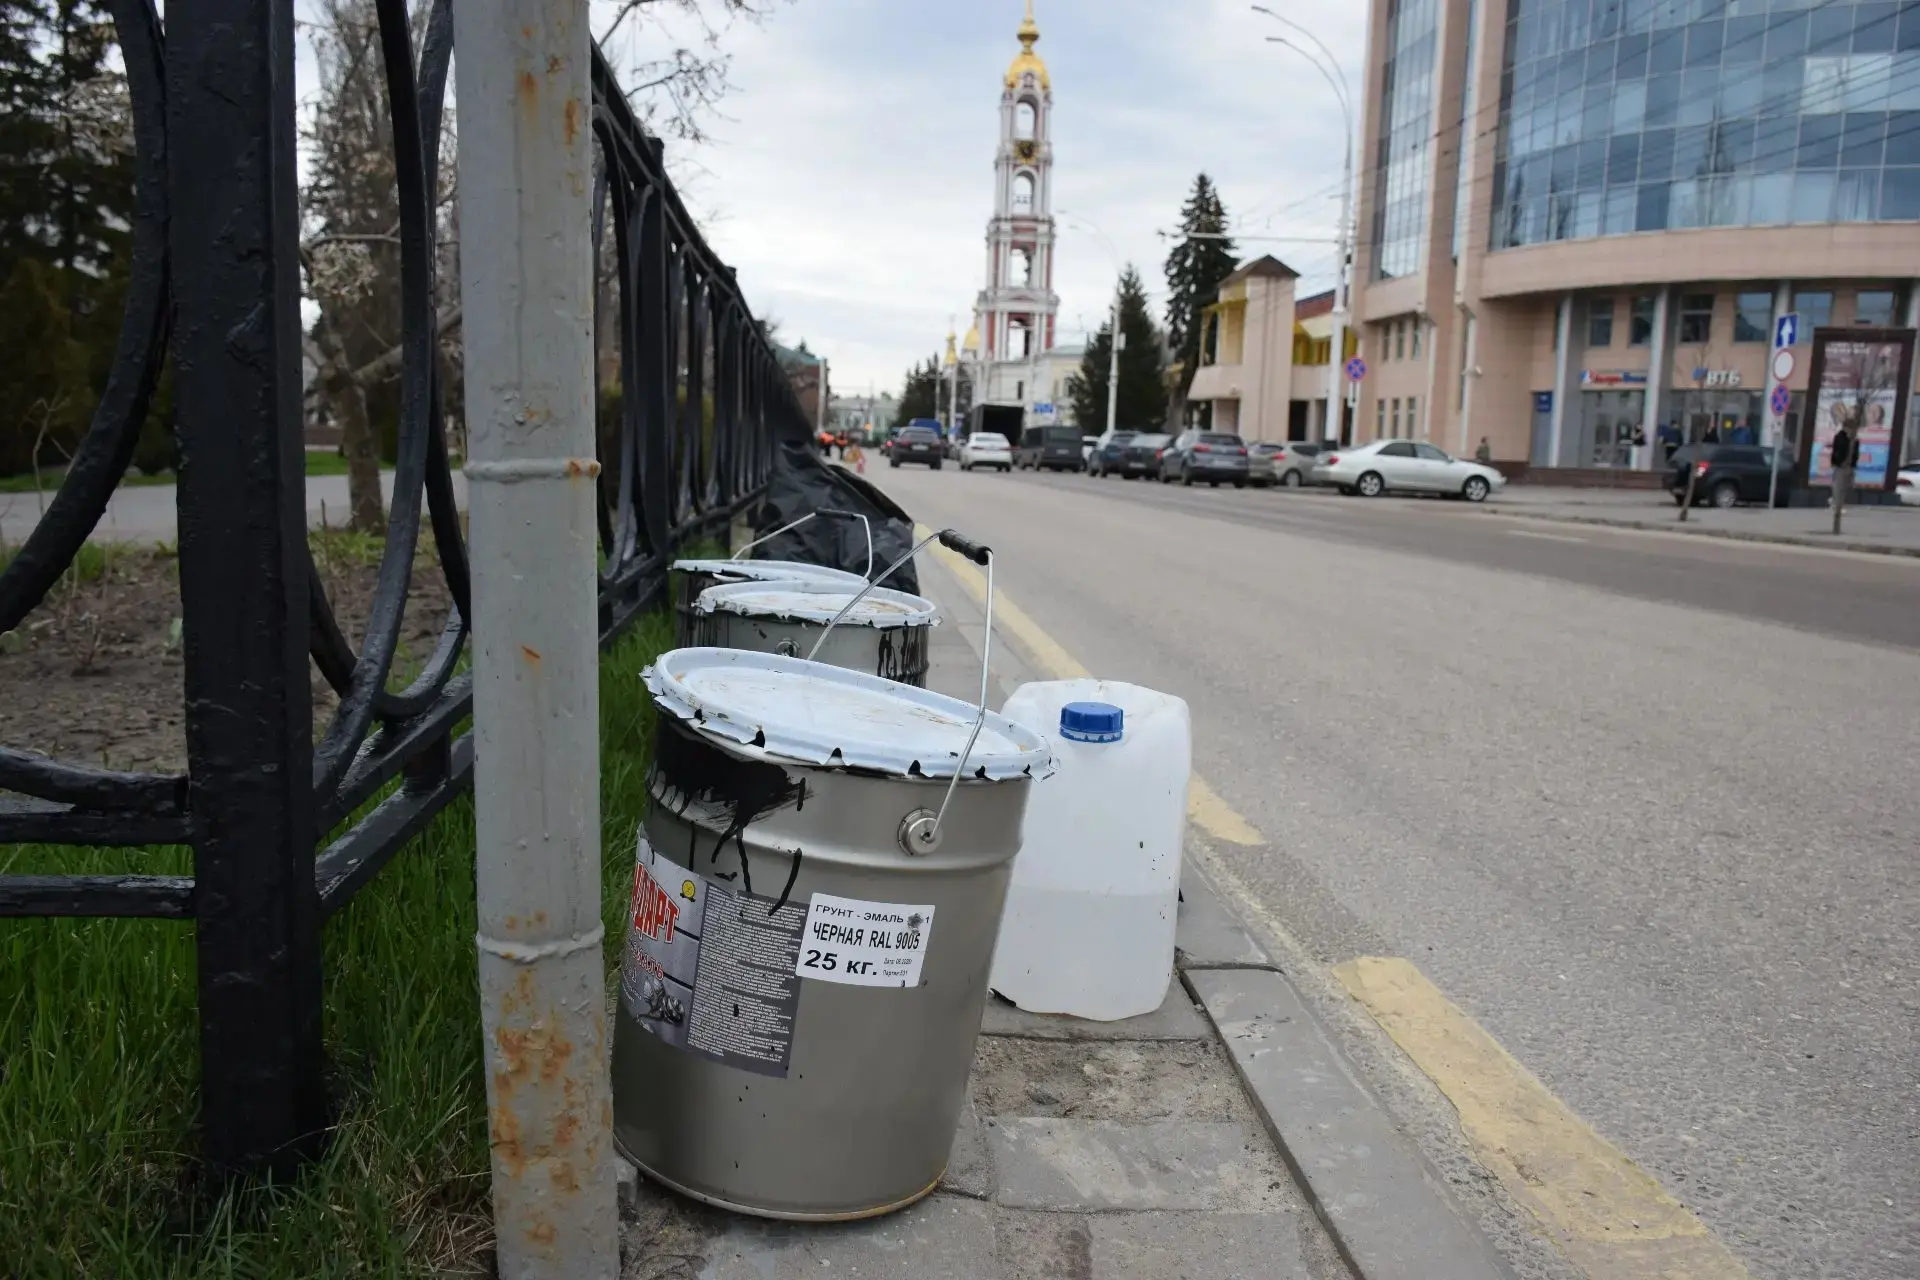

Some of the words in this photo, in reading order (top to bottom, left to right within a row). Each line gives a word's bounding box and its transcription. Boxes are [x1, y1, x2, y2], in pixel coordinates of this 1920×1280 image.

[1705, 370, 1741, 385] ВТБ
[815, 904, 854, 918] ГРУНТ
[863, 912, 904, 923] ЭМАЛЬ
[813, 921, 864, 946] ЧЕРНАЯ
[868, 930, 892, 949] RAL
[895, 932, 921, 950] 9005
[804, 949, 838, 971] 25
